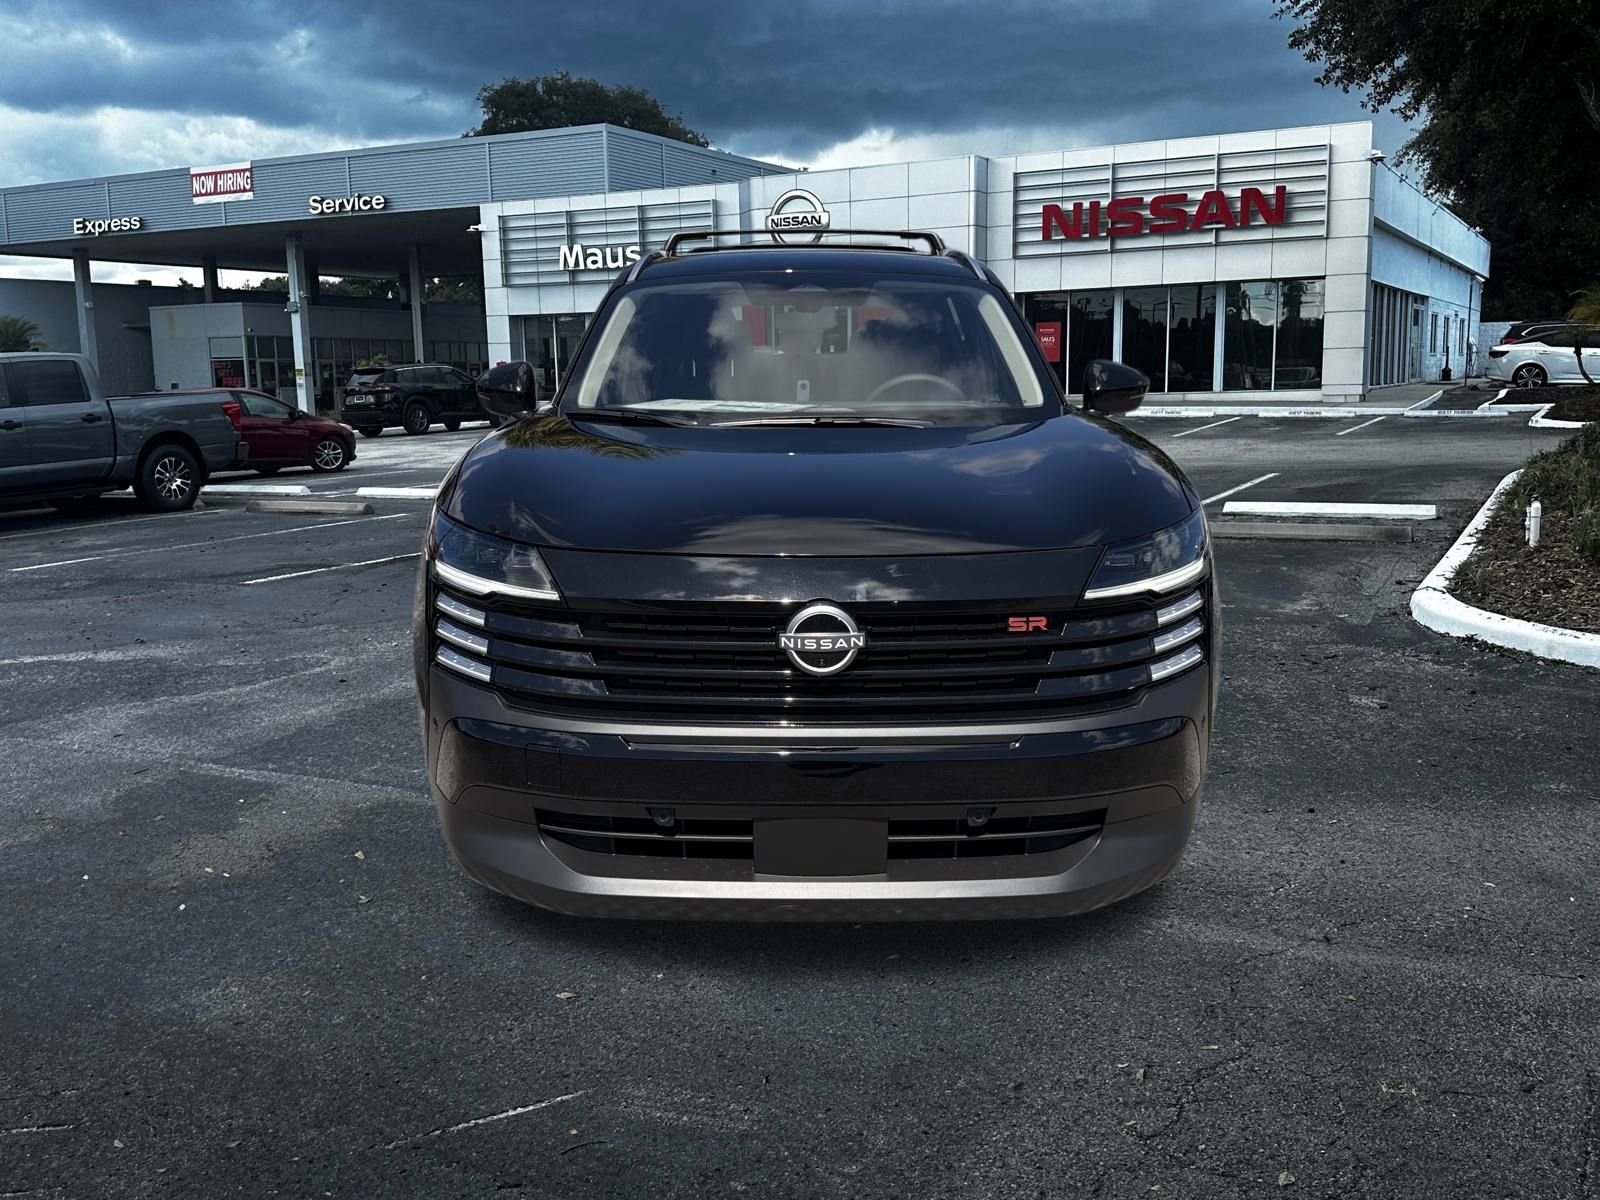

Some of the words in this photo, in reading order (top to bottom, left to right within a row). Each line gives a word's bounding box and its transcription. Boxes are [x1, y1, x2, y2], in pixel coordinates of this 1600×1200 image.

[191, 175, 215, 195] NOW
[217, 171, 252, 193] HIRING
[308, 192, 386, 215] Service
[1041, 185, 1287, 241] NISSAN
[72, 215, 141, 237] Express
[770, 214, 822, 229] NISSAN
[558, 243, 642, 271] Maus
[1007, 616, 1048, 632] SR
[780, 635, 864, 650] NISSAN
